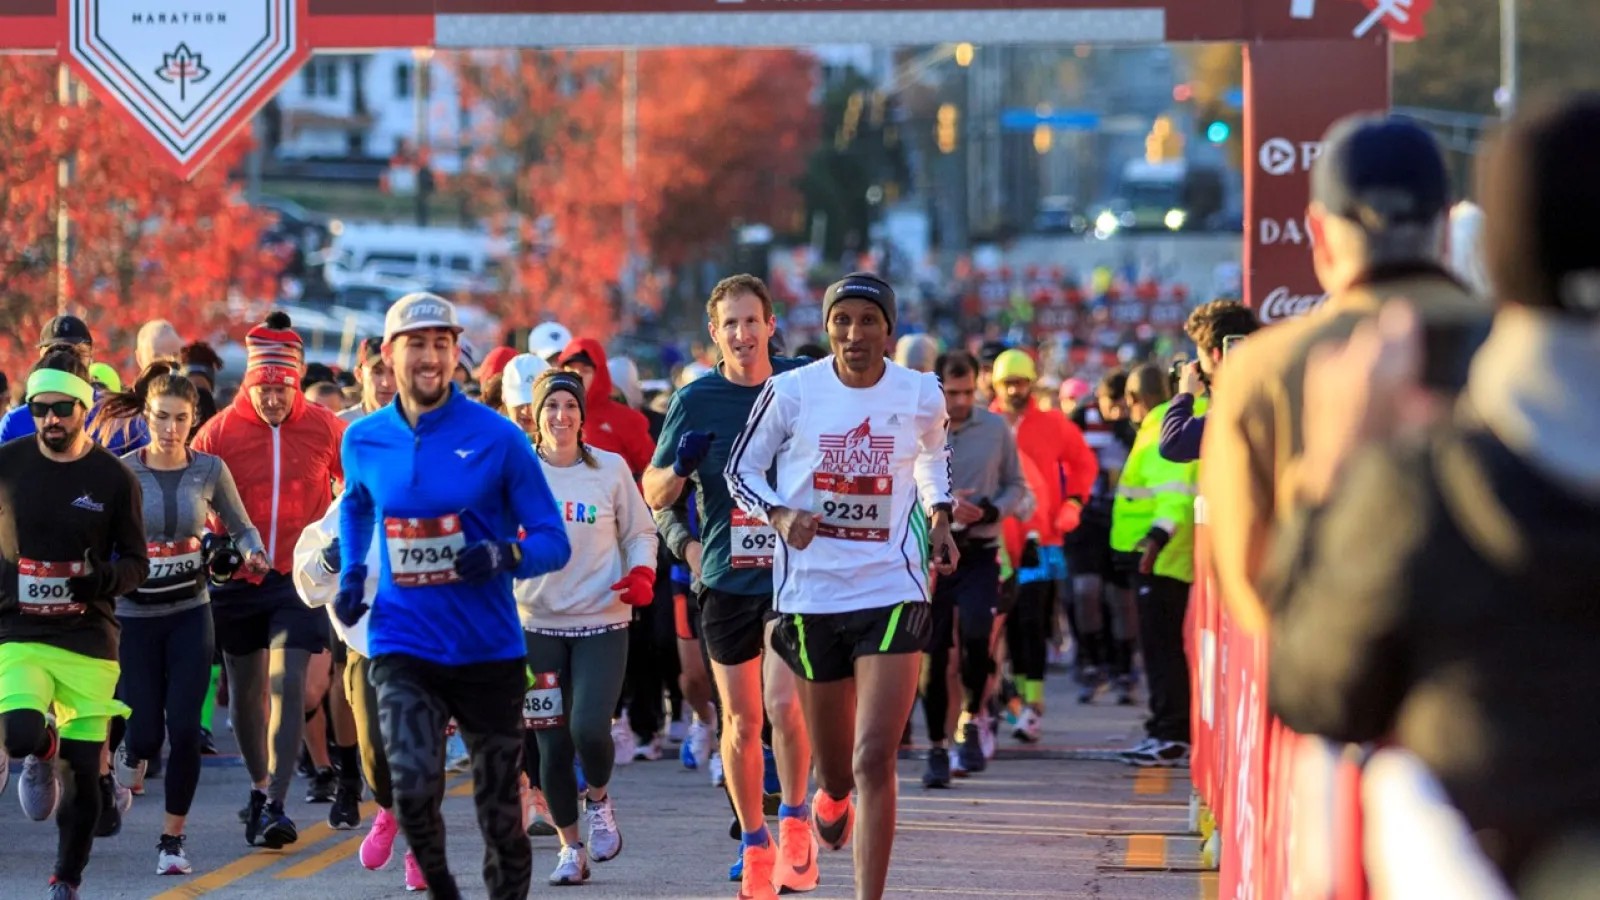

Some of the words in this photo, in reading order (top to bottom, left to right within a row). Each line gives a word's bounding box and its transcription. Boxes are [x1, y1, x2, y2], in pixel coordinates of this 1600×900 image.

[131, 12, 227, 24] MARATHON
[823, 450, 890, 464] ATLANTA
[859, 463, 889, 475] CLUB
[823, 501, 878, 521] 9234
[742, 534, 776, 549] 693
[398, 545, 453, 565] 7934
[153, 560, 195, 577] 7739
